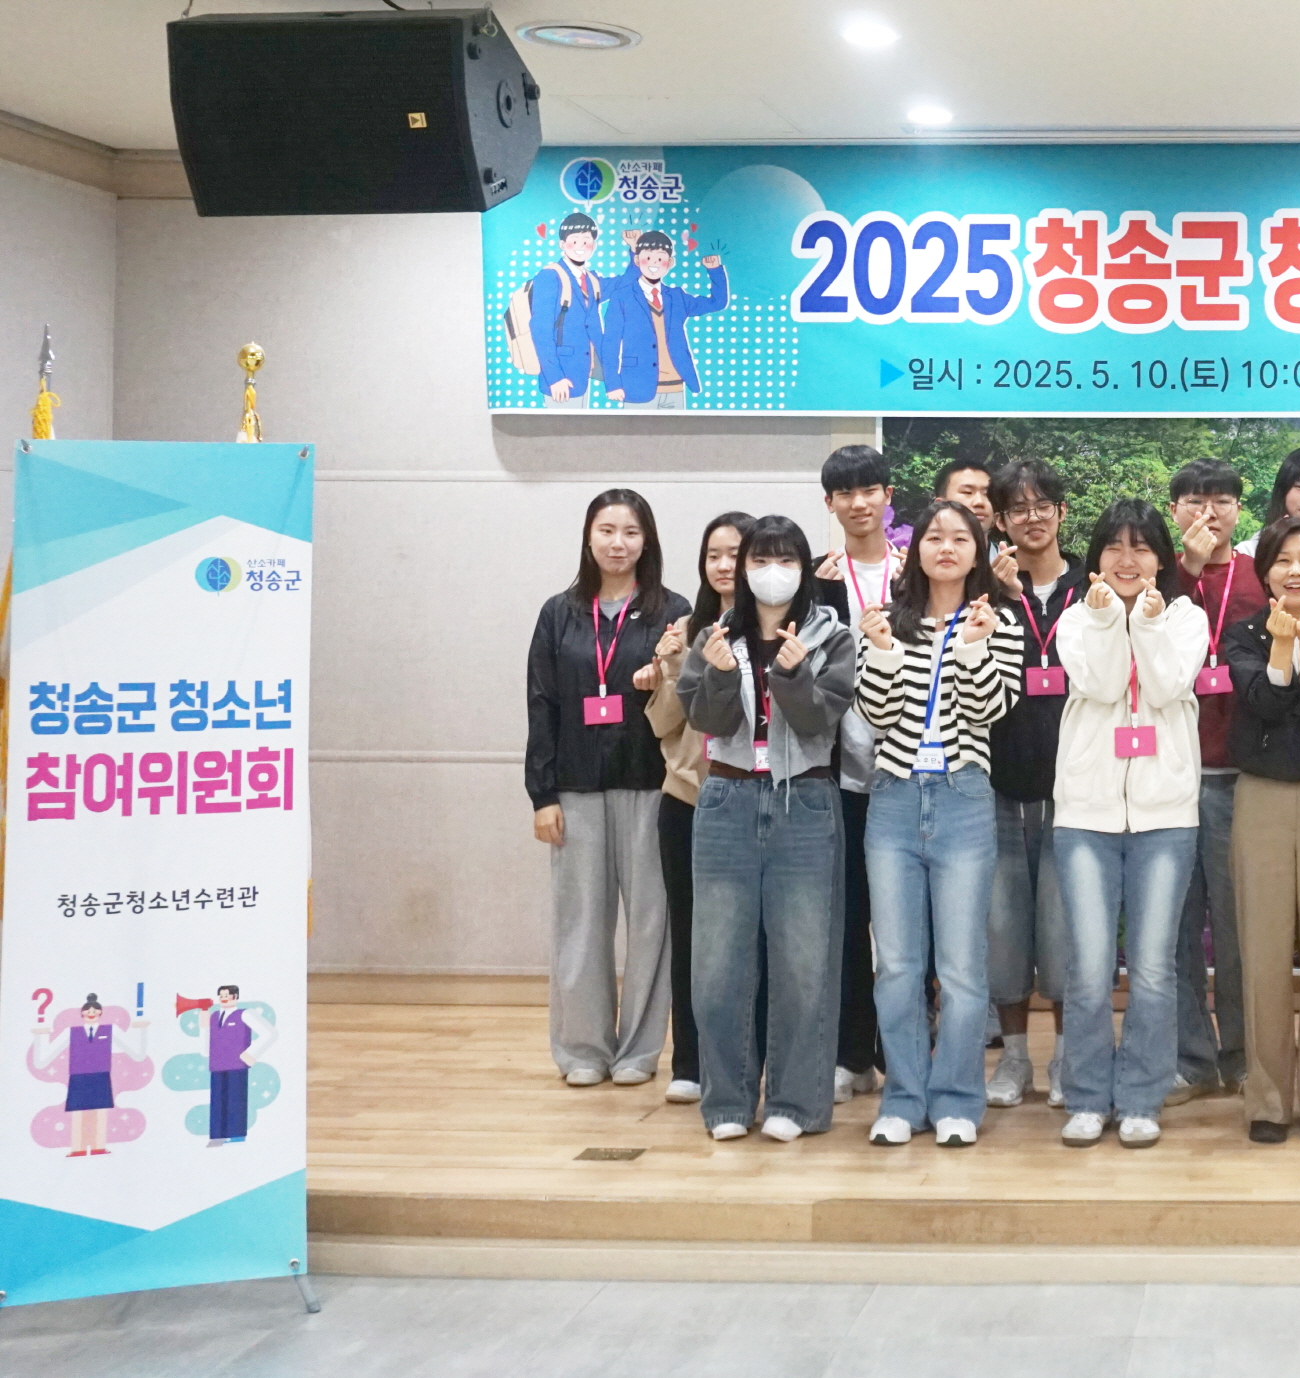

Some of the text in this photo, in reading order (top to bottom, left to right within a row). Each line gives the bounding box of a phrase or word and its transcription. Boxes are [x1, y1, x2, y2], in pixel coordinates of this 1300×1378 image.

[619, 161, 663, 173] 산소카페
[618, 175, 682, 200] 청송군
[800, 220, 1013, 315] 2025
[1033, 217, 1244, 325] 청송군
[908, 357, 964, 391] 일시
[993, 359, 1082, 390] 2025.
[1091, 359, 1119, 390] 5.
[246, 558, 286, 568] 산소카페
[245, 570, 302, 592] 청송군
[29, 679, 292, 735] 청송군 청소년
[26, 746, 294, 821] 참여위원회
[57, 885, 259, 918] 청송군청소년수련관
